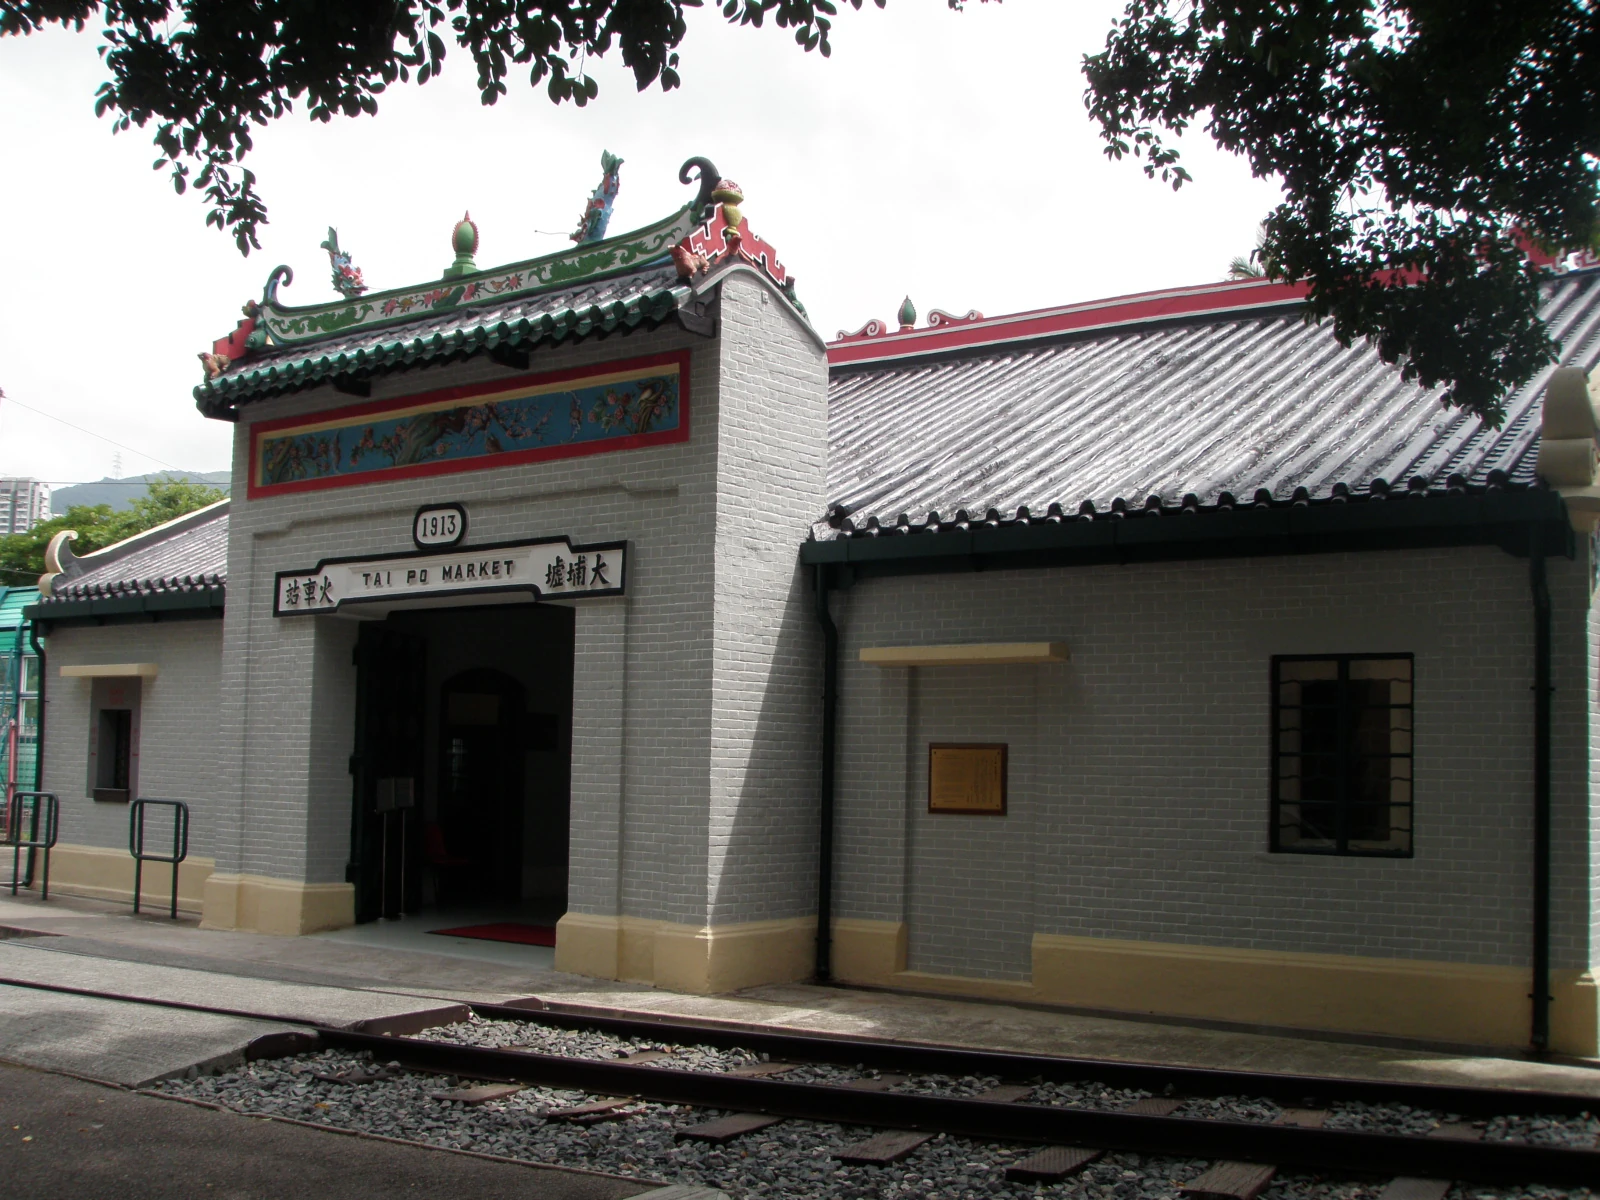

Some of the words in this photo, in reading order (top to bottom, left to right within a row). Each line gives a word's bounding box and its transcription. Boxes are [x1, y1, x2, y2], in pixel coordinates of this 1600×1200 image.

[422, 515, 456, 537] 1913
[363, 571, 391, 586] TAI
[407, 569, 428, 584] PO
[442, 560, 514, 581] MARKET
